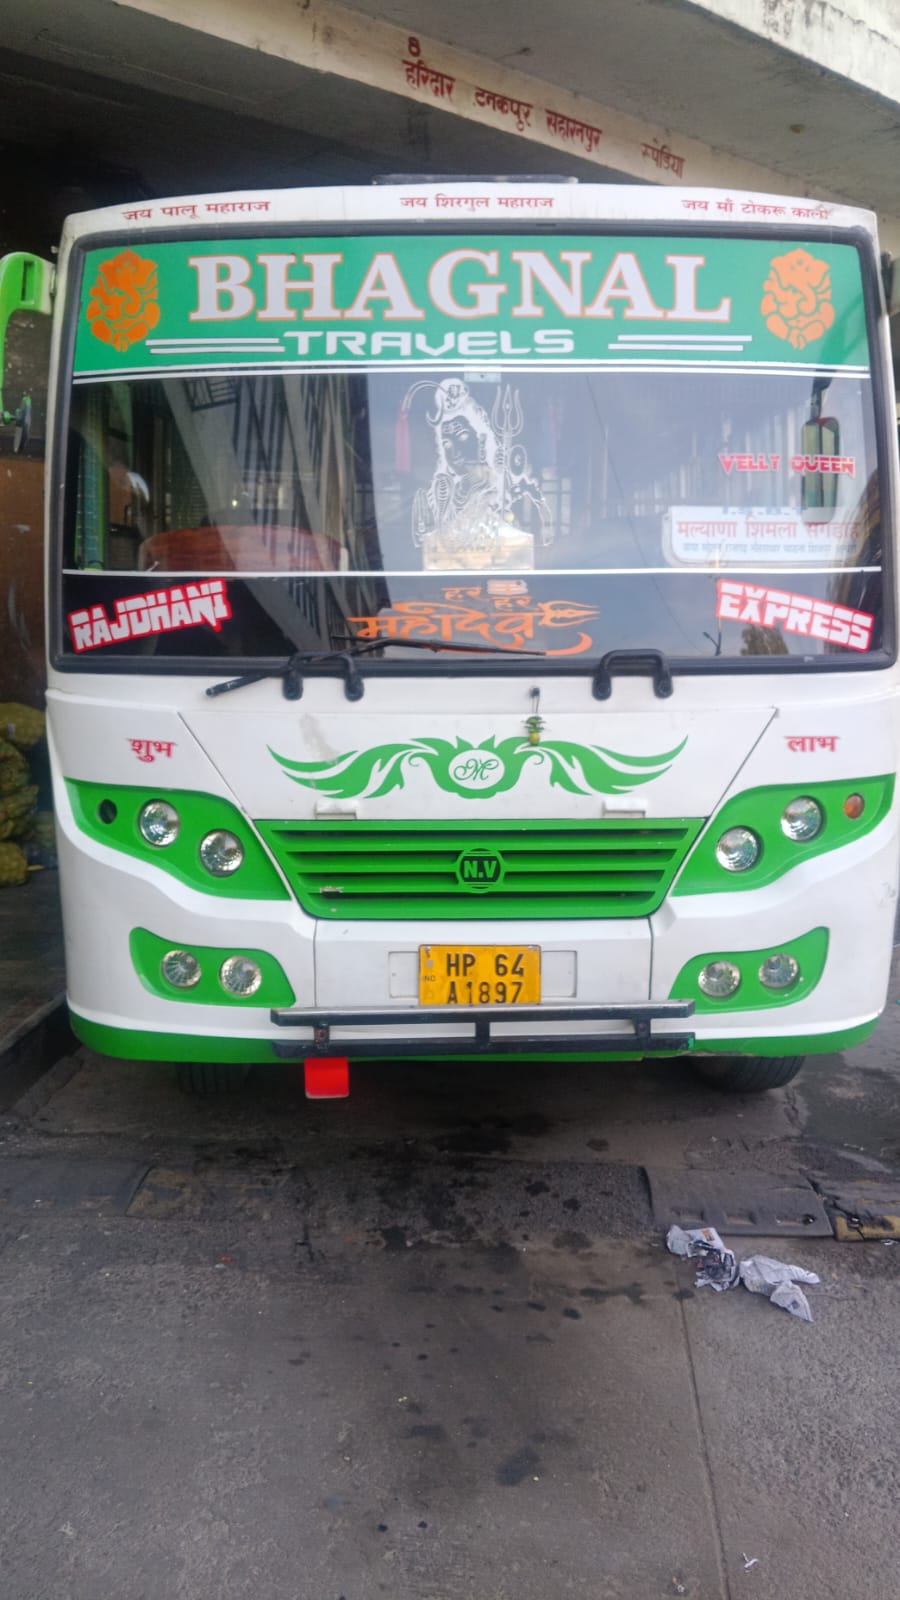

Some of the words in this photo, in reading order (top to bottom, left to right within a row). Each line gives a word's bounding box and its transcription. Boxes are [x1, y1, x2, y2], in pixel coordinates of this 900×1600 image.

[408, 37, 421, 57] 8
[122, 207, 152, 221] जय
[205, 200, 271, 213] महाराज
[400, 196, 428, 208] जय
[435, 193, 490, 212] शिरगुल
[497, 196, 554, 208] महाराज
[681, 199, 709, 211] जय
[187, 248, 732, 324] BHAGNAL
[283, 329, 575, 356] TRAVELS
[719, 454, 781, 473] VELLY
[790, 455, 855, 479] QUEEN
[745, 515, 798, 538] शिमला
[441, 586, 482, 602] हर
[68, 577, 232, 653] RAJDHANI
[716, 579, 875, 653] EXPRESS
[346, 600, 595, 656] महादेव
[126, 736, 178, 763] शुभ
[783, 735, 841, 753] लाभ
[463, 860, 497, 878] N.V
[446, 953, 476, 977] HP
[494, 953, 525, 977] 64
[446, 980, 524, 1005] A1897
